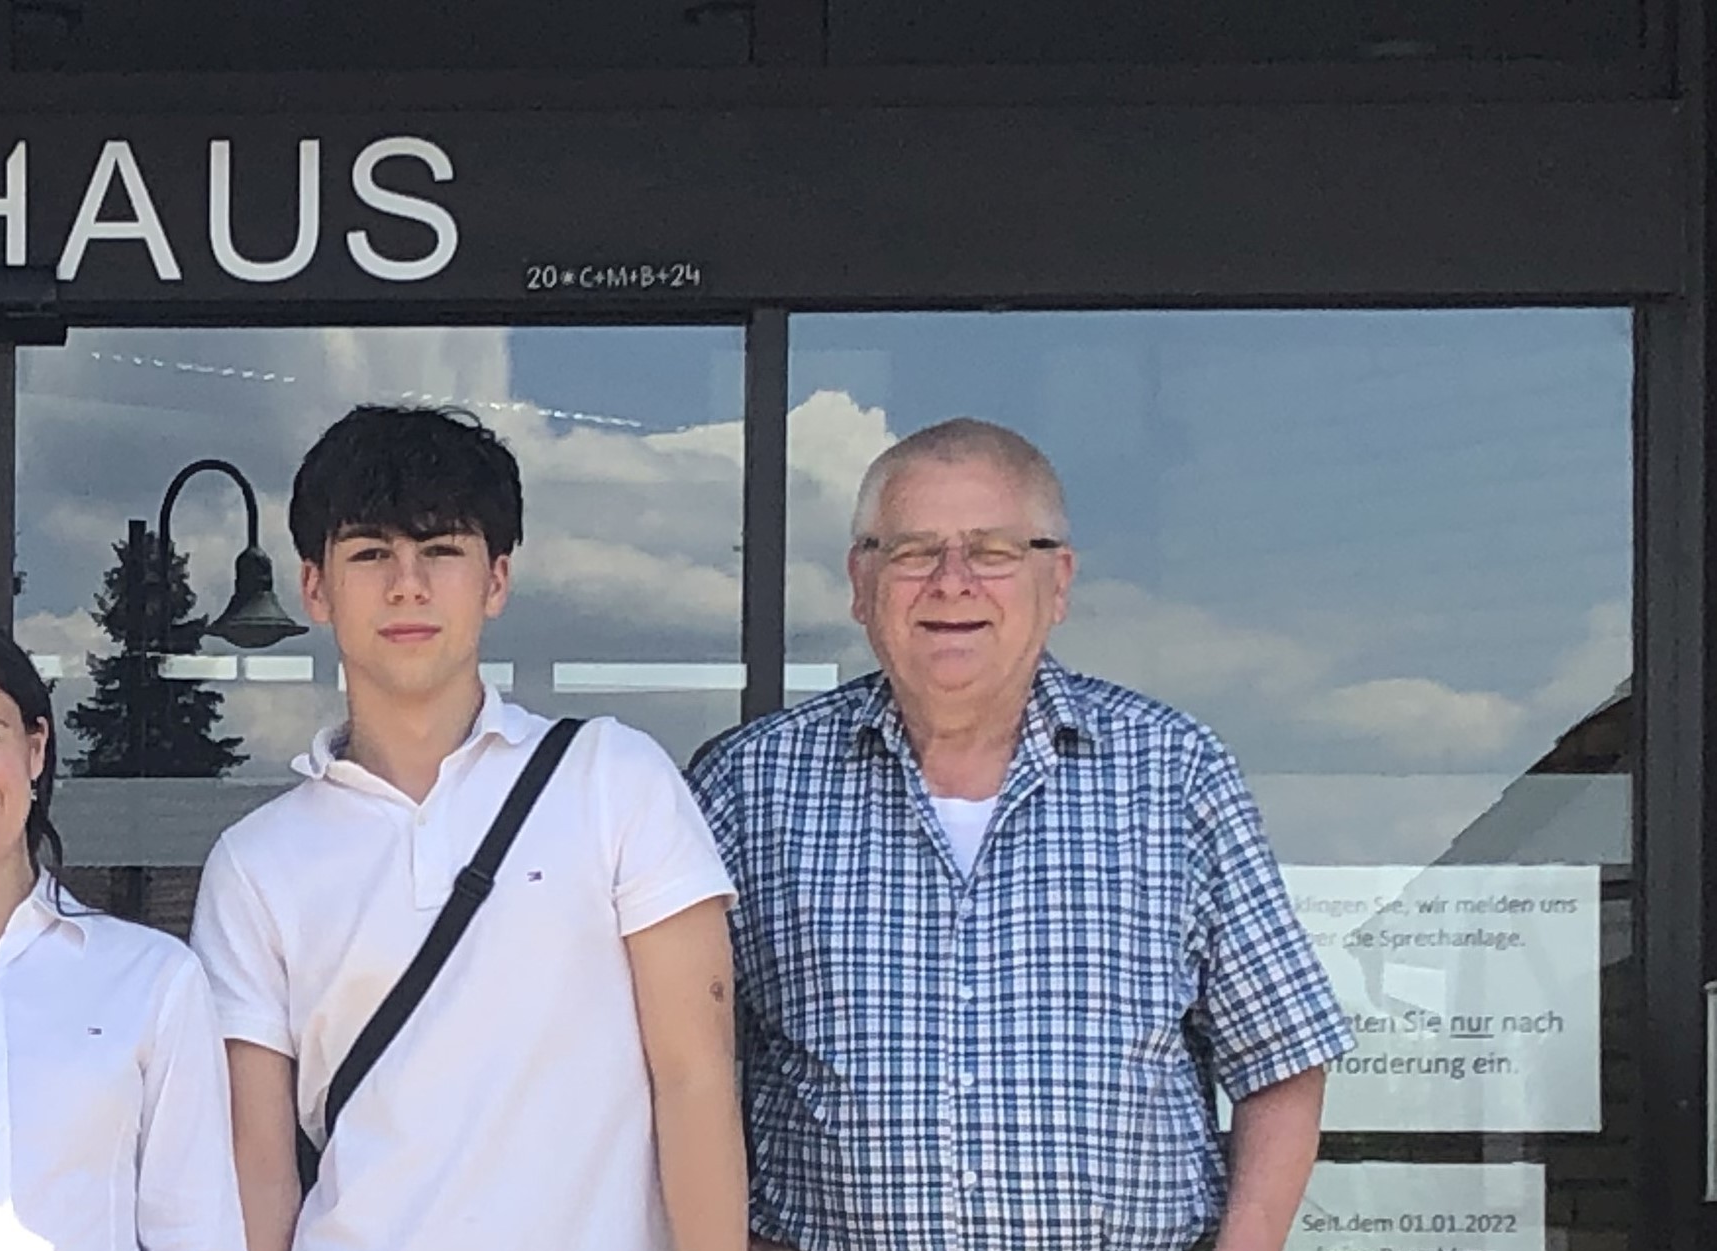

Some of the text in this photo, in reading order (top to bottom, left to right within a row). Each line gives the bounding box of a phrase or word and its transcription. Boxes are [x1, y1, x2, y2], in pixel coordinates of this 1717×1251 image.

[1417, 895, 1449, 915] wir
[1540, 897, 1578, 915] uns
[1379, 929, 1526, 951] Sprechanlage.
[1403, 1010, 1442, 1034] Sie
[1450, 1014, 1494, 1035] nur
[1501, 1010, 1564, 1034] nach
[1301, 1213, 1517, 1233] Seit dem 01.01.2022
